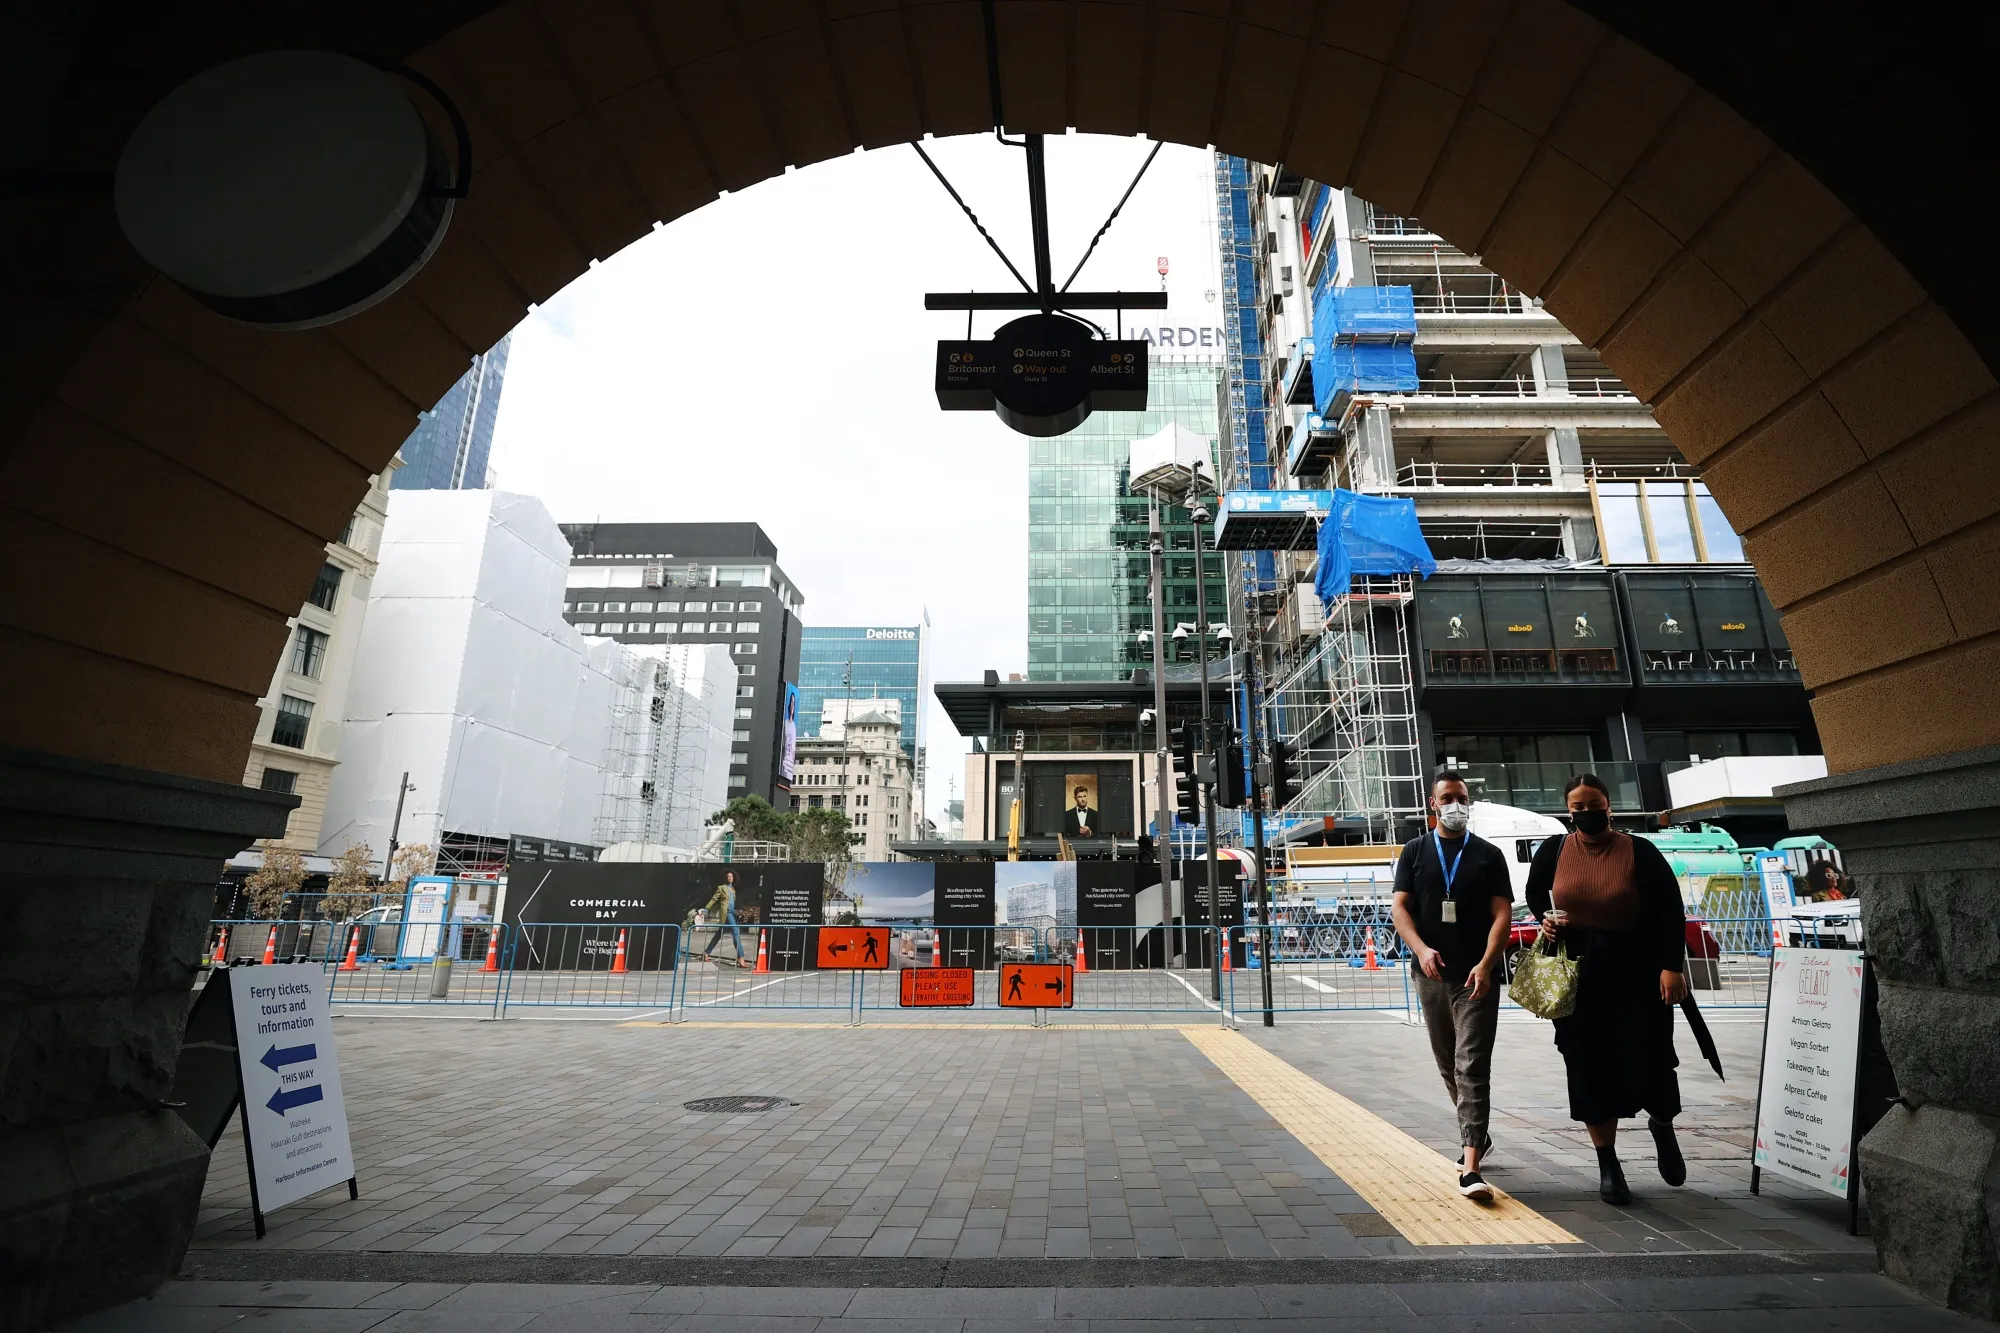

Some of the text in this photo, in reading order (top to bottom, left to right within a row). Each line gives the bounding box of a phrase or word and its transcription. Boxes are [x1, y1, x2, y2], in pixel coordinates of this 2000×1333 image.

[1026, 348, 1071, 359] Queen St
[948, 365, 996, 374] Britomart
[1025, 365, 1067, 375] Way out
[1090, 365, 1135, 374] Albert St
[866, 629, 915, 639] Deloitte
[570, 899, 646, 907] COMMERCIAL
[583, 948, 620, 956] City Begin
[1801, 956, 1831, 966] Island
[906, 970, 968, 980] CROSSING CLOSED
[1799, 969, 1831, 996] GELATO
[250, 982, 312, 1000] Ferry tickets,
[915, 982, 957, 991] PLEASE USE
[903, 993, 971, 1002] ALTERNATIVE CROSSING
[1797, 995, 1828, 1011] Company
[261, 999, 306, 1016] tours and
[257, 1016, 315, 1035] Information
[1791, 1016, 1832, 1029] Artisan Gelato
[1790, 1038, 1829, 1053] Vegan Sorbet
[1786, 1059, 1830, 1077] Takeaway Tubs
[281, 1069, 315, 1085] THIS WAY
[1784, 1083, 1828, 1102] Allpress Coffee
[1784, 1106, 1823, 1125] Gelato cakes
[270, 1125, 332, 1150] Hauraki Gulf destinations
[286, 1142, 323, 1160] and attractions
[275, 1157, 338, 1184] Harbour Information Centre
